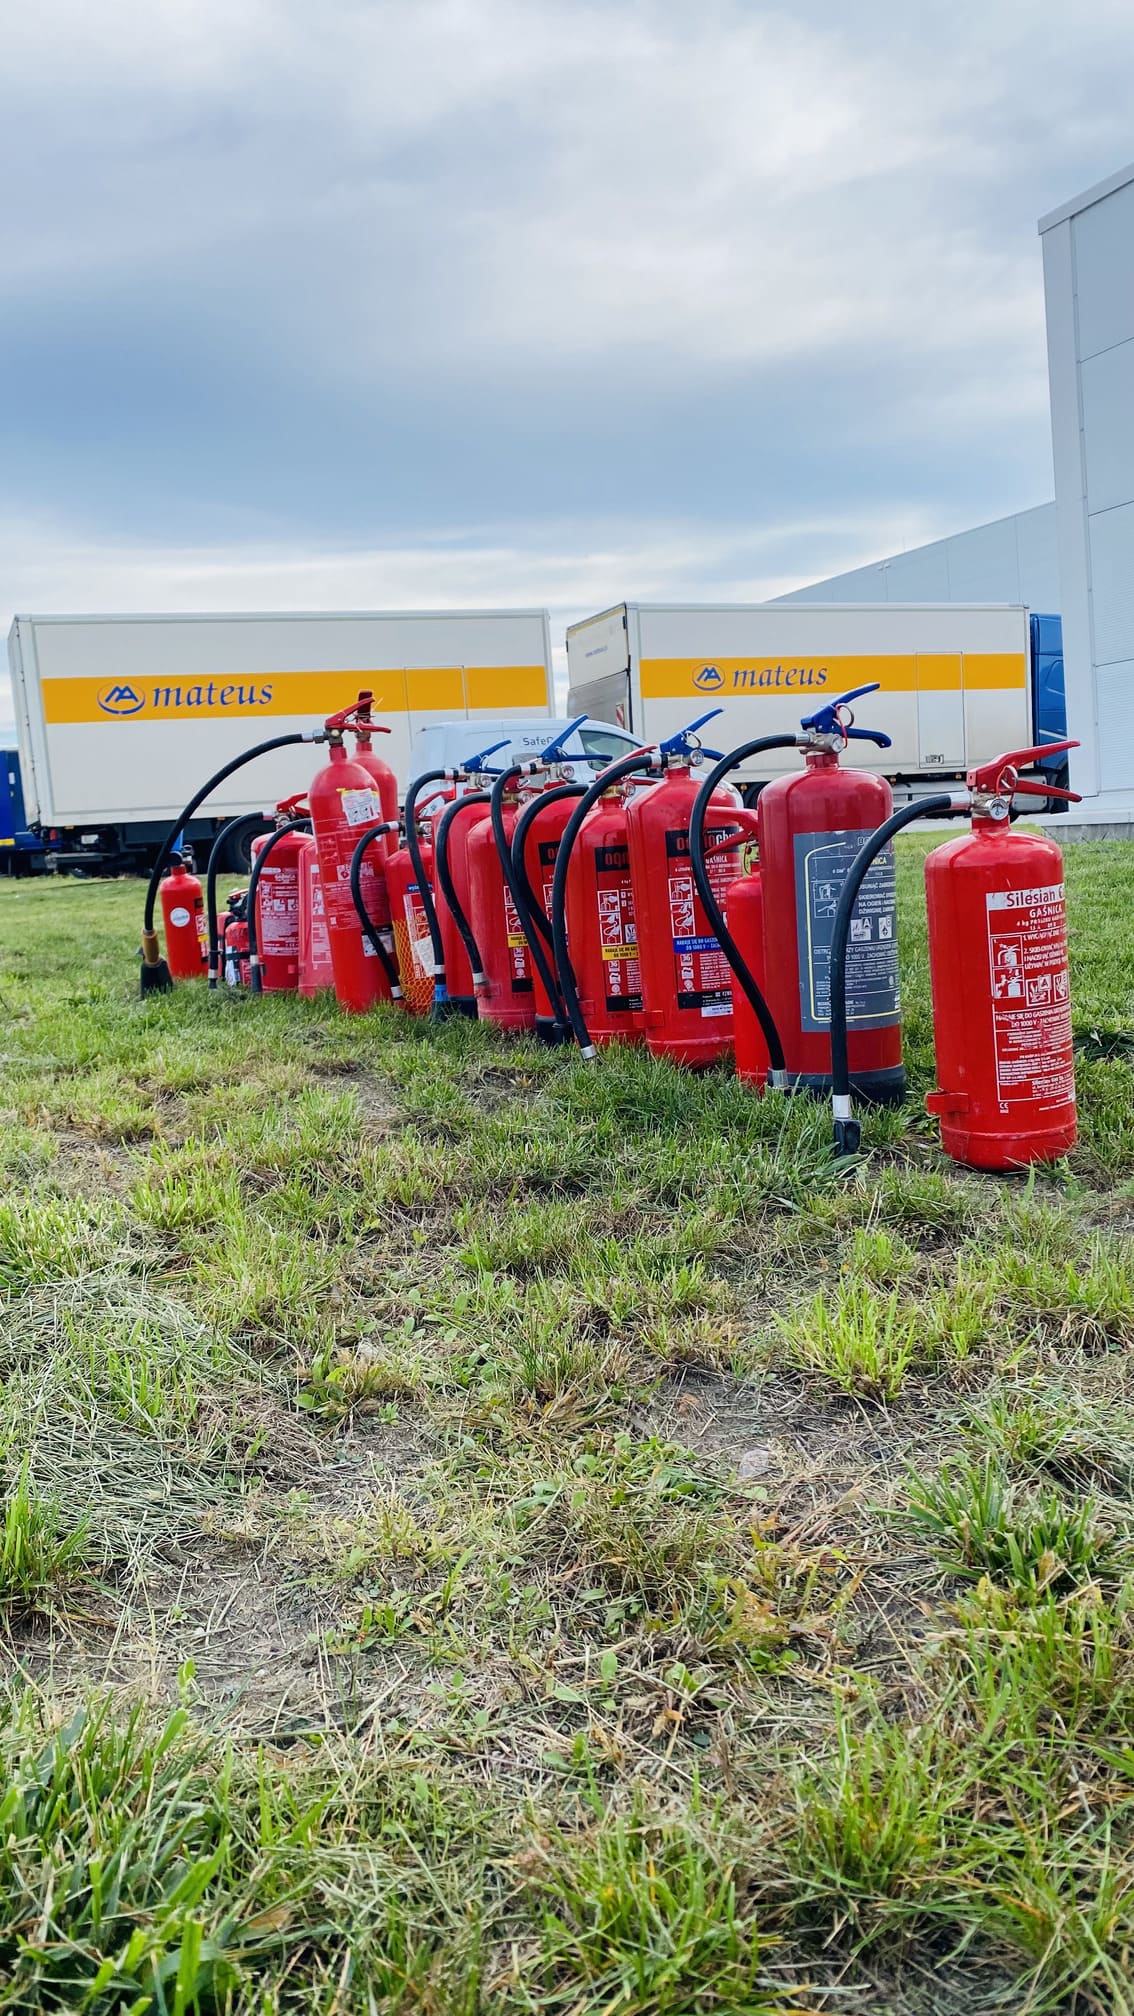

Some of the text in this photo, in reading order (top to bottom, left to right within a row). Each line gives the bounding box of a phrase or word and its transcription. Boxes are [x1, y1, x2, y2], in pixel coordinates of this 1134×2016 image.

[733, 665, 828, 687] mateus
[152, 682, 273, 707] mateus
[1006, 889, 1056, 907] Silesian
[1041, 976, 1049, 988] A
